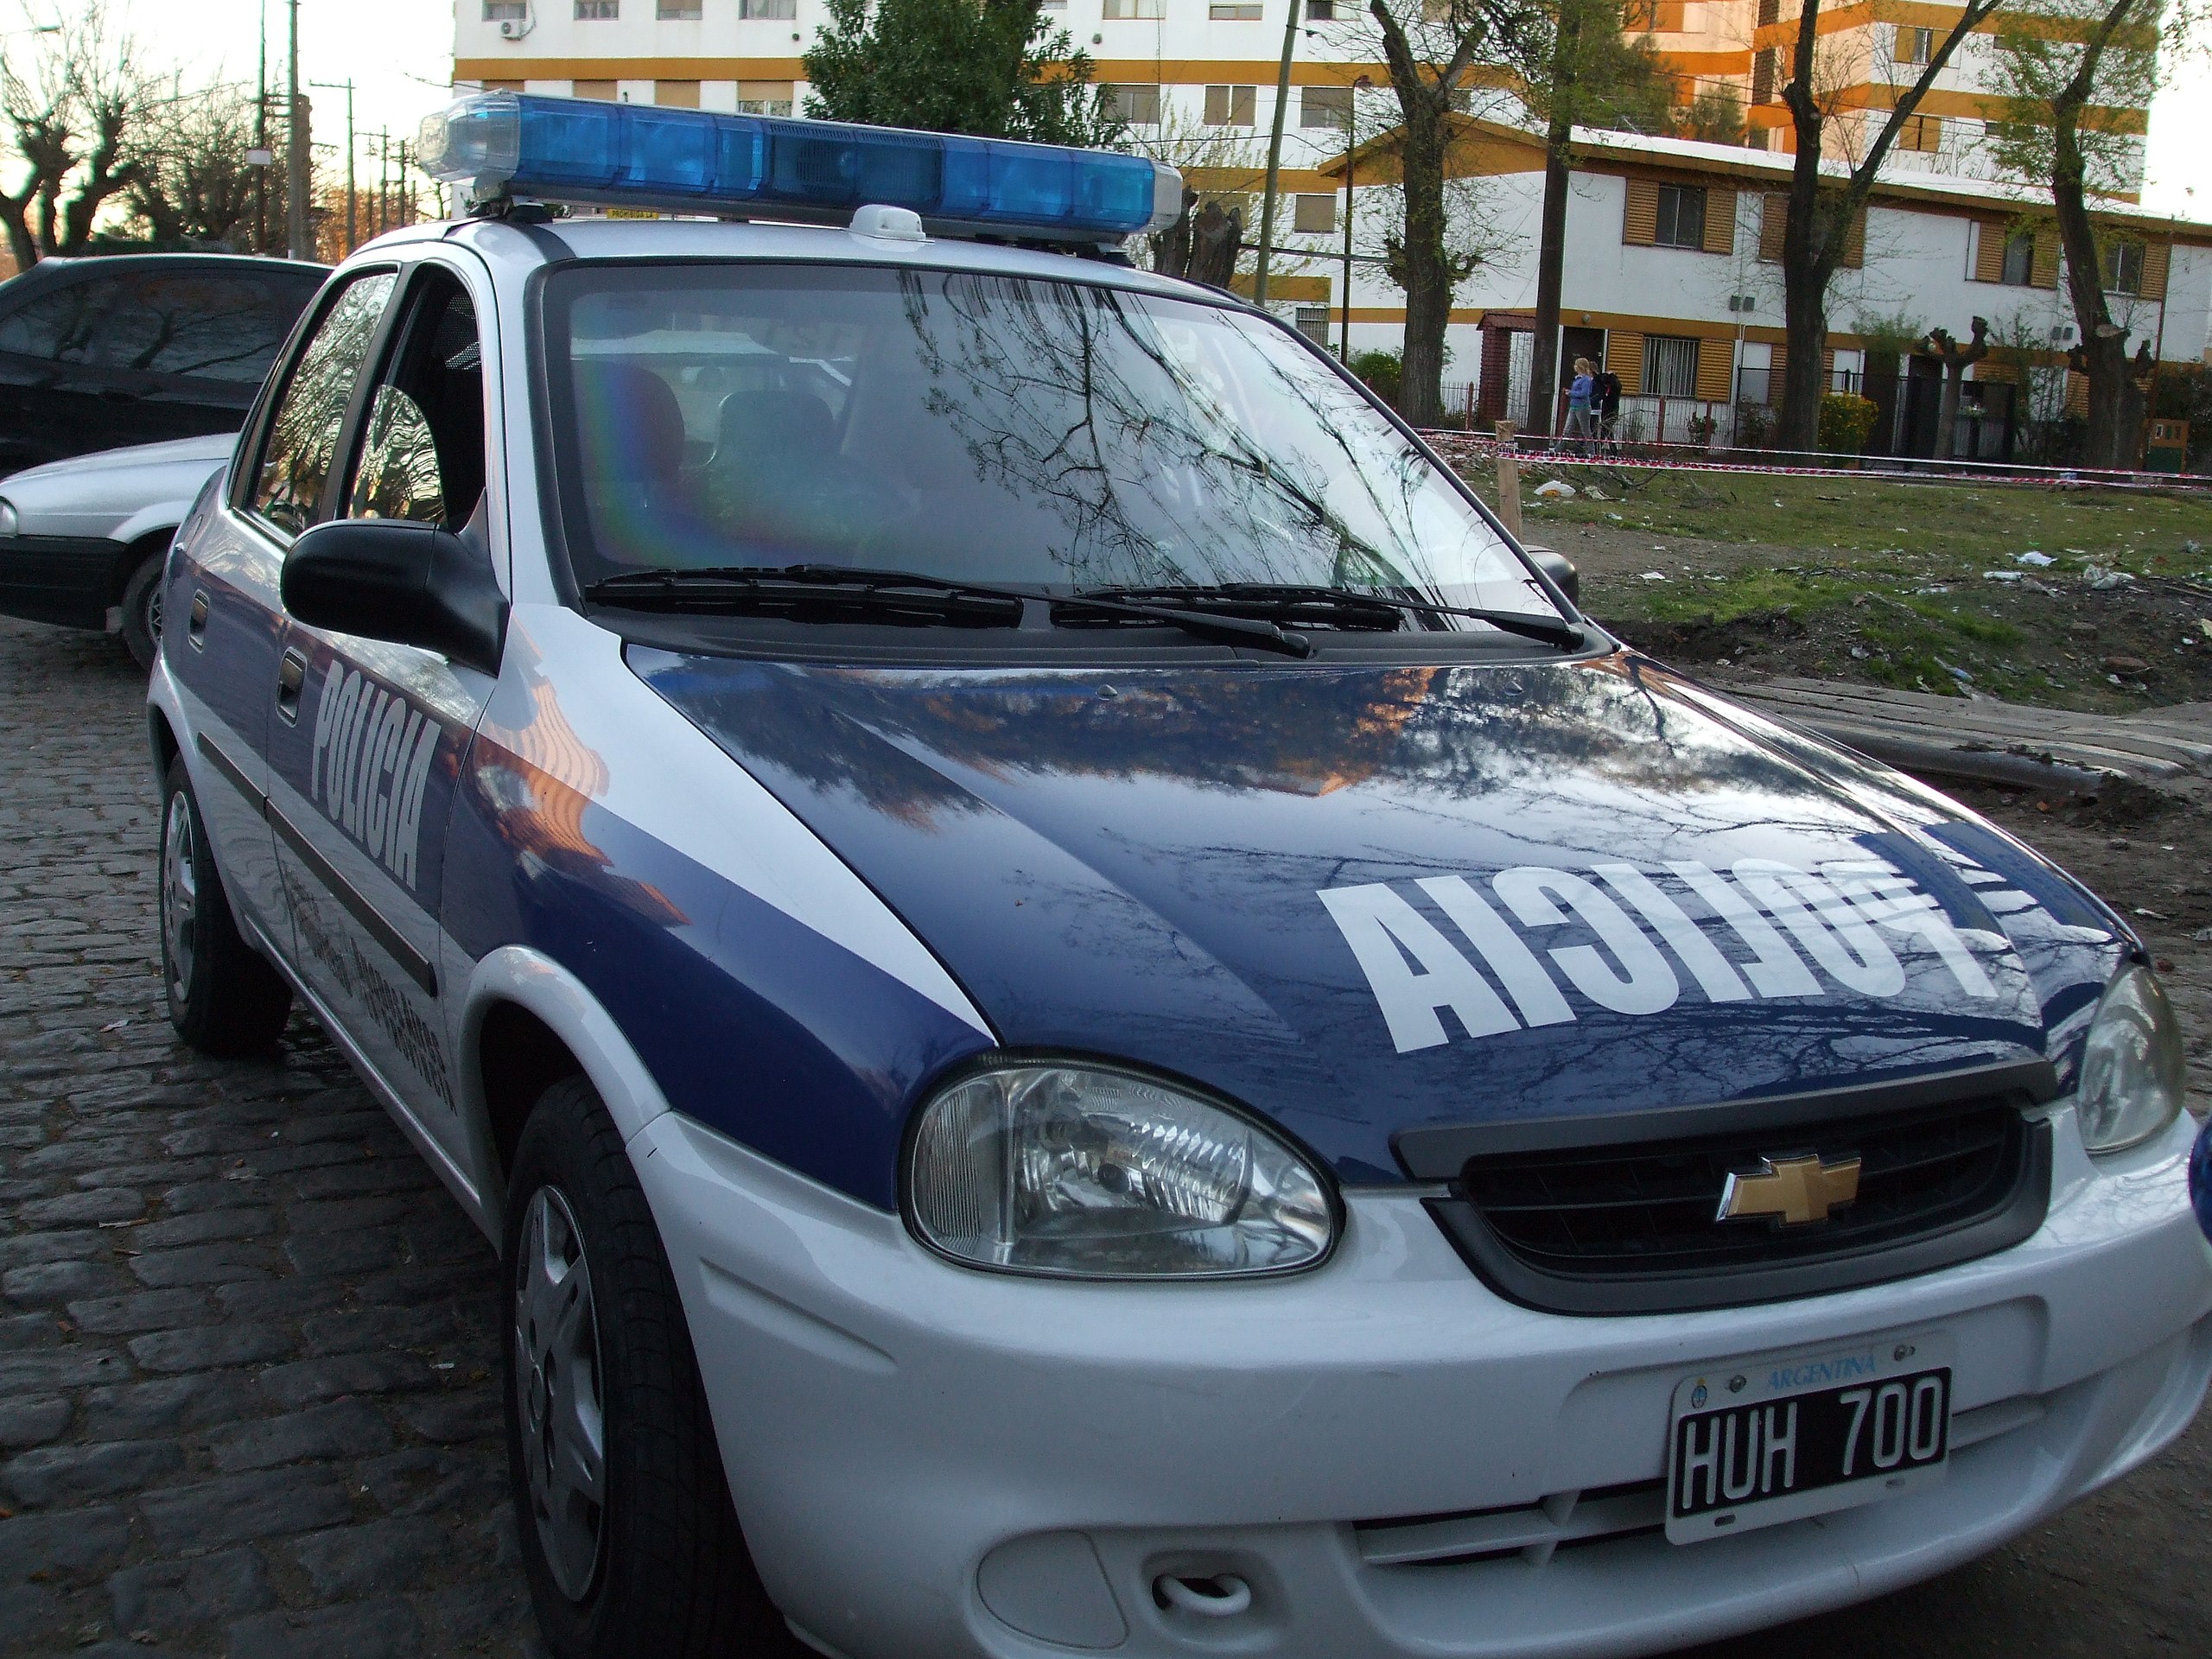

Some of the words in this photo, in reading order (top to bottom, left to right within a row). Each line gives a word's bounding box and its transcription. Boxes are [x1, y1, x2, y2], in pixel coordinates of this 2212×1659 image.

[312, 659, 442, 892] POLICIA
[1769, 1354, 1876, 1389] ARGENTINA
[1681, 1402, 1797, 1509] HUH
[1840, 1376, 1943, 1476] 700
